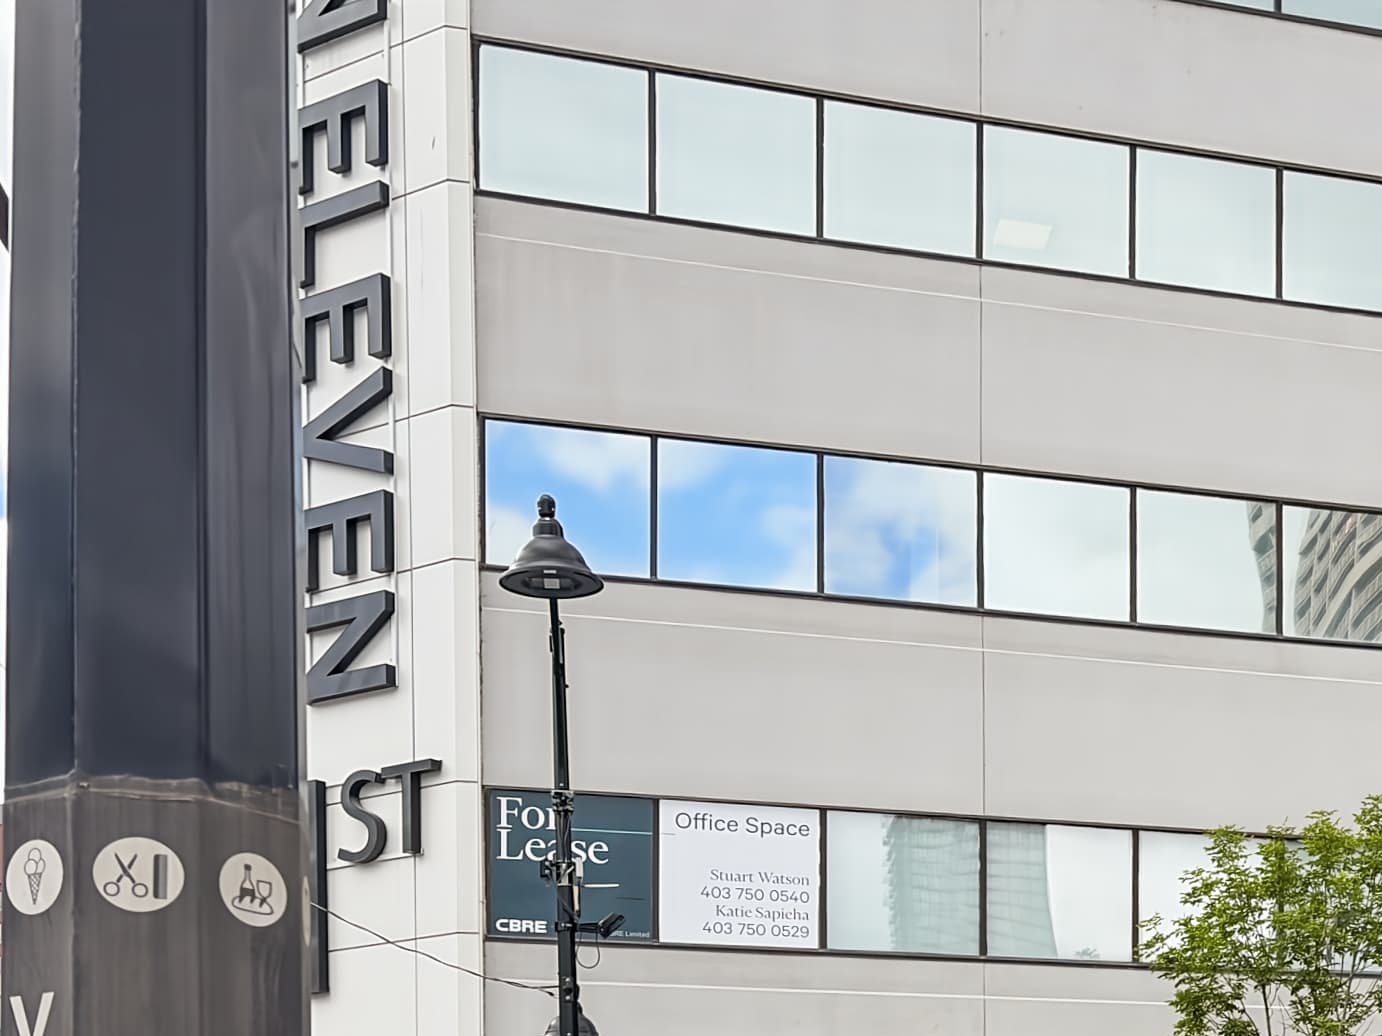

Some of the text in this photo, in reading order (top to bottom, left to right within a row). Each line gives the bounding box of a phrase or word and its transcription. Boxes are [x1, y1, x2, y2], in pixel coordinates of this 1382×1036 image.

[298, 79, 397, 705] ELEVEN
[675, 812, 811, 838] Office Space
[710, 868, 810, 886] Stuart Watson
[700, 886, 810, 904] 403 750 0540
[716, 904, 753, 918] Katie
[495, 919, 547, 933] CBRE
[702, 921, 810, 938] 403 750 0529
